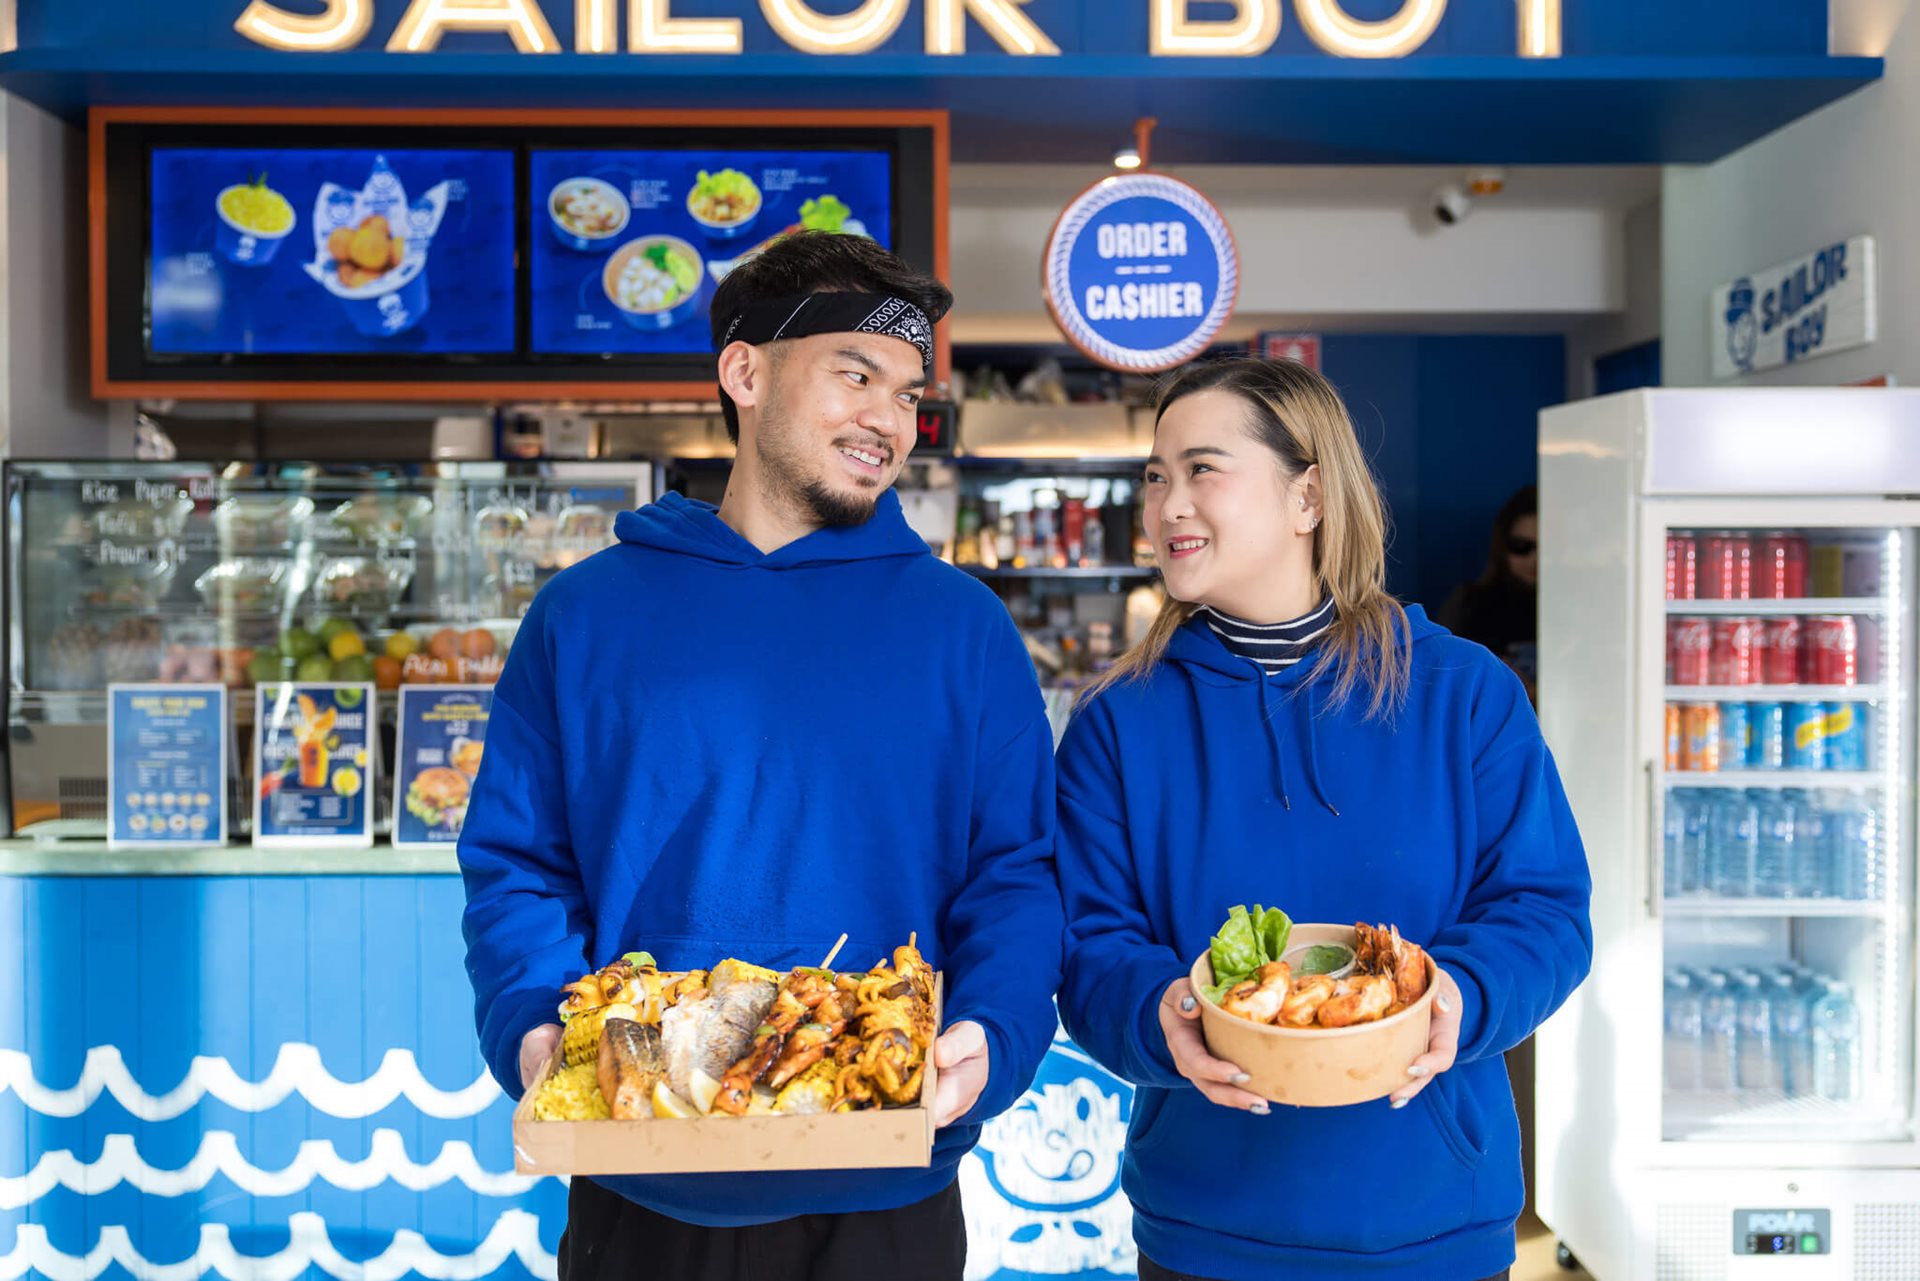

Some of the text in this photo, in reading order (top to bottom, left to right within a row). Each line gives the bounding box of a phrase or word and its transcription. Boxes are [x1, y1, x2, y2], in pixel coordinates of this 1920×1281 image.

[1097, 221, 1188, 259] ORDER
[1762, 241, 1847, 334] SAILOR
[1784, 303, 1828, 364] BOY
